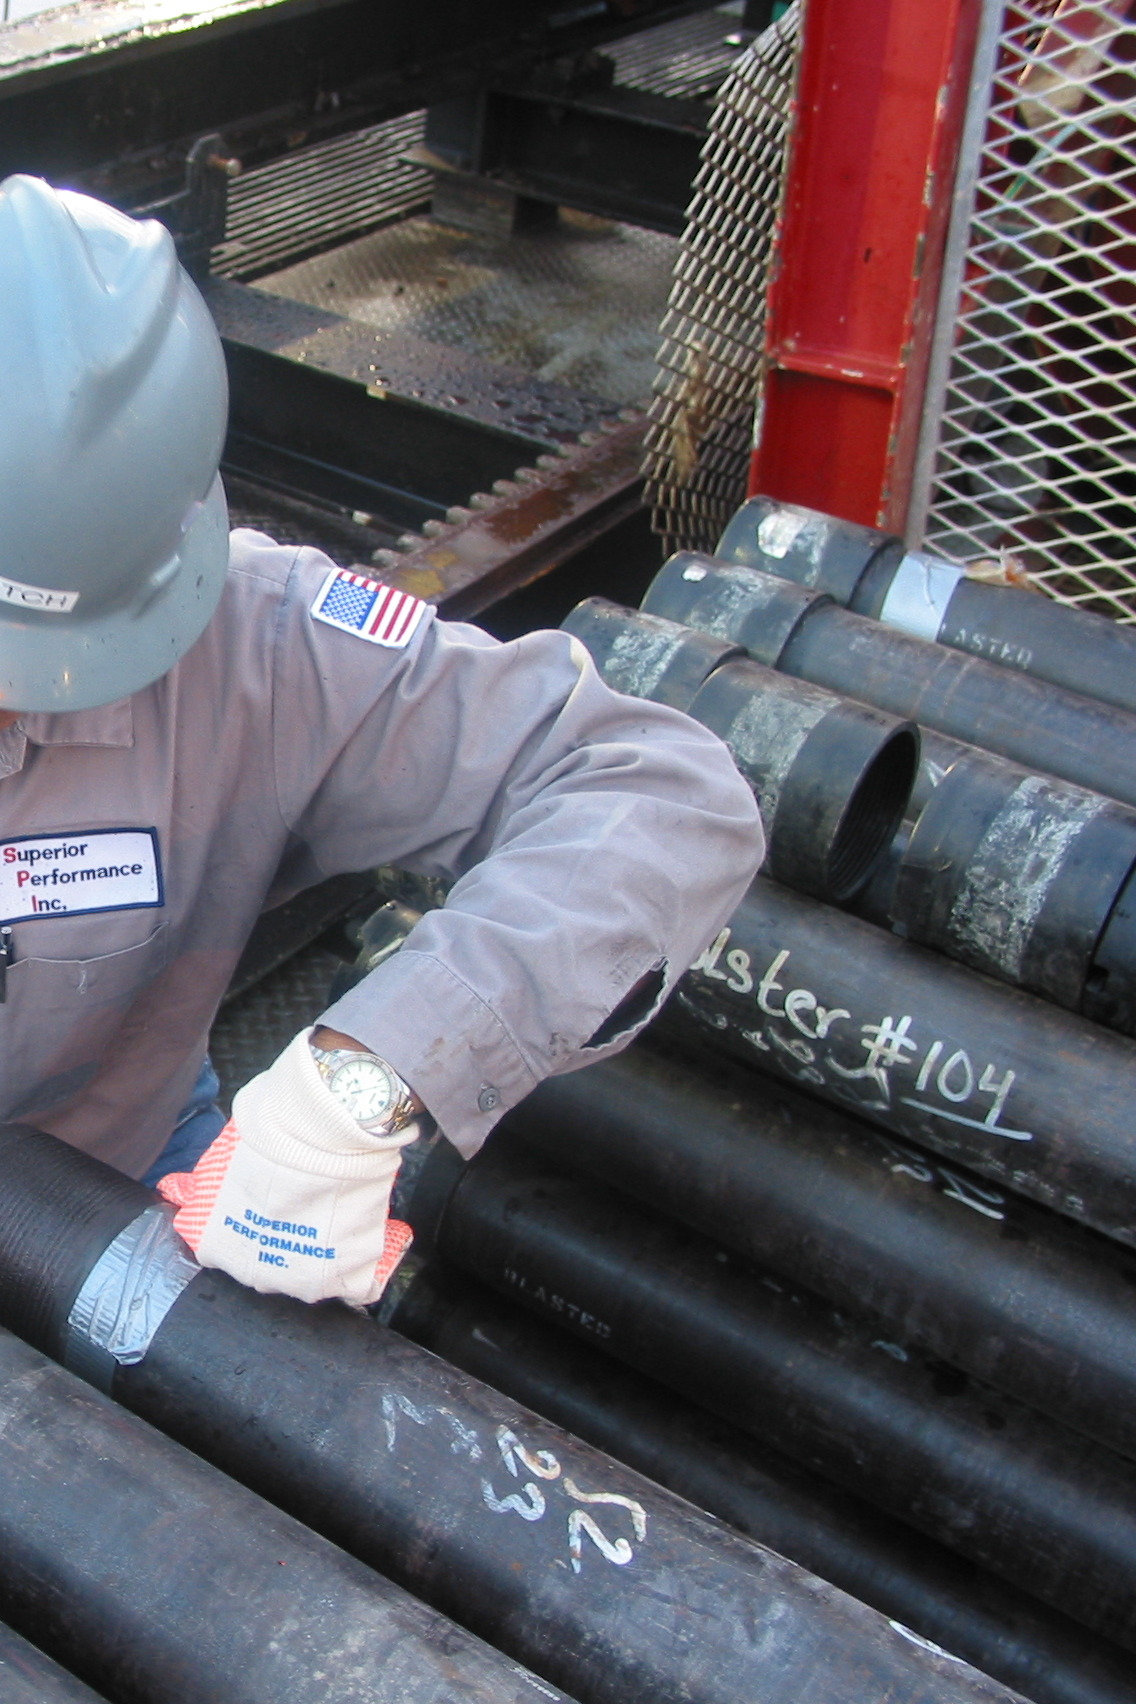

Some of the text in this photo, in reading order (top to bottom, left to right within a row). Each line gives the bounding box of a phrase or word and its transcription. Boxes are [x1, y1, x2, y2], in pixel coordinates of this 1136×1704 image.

[2, 842, 89, 867] Superior
[16, 863, 144, 888] Performance
[31, 894, 68, 913] Inc.
[861, 1014, 1017, 1130] #104
[244, 1208, 319, 1240] SUPERIOR
[224, 1215, 337, 1260] PERFORMANCE
[258, 1250, 290, 1269] INC.
